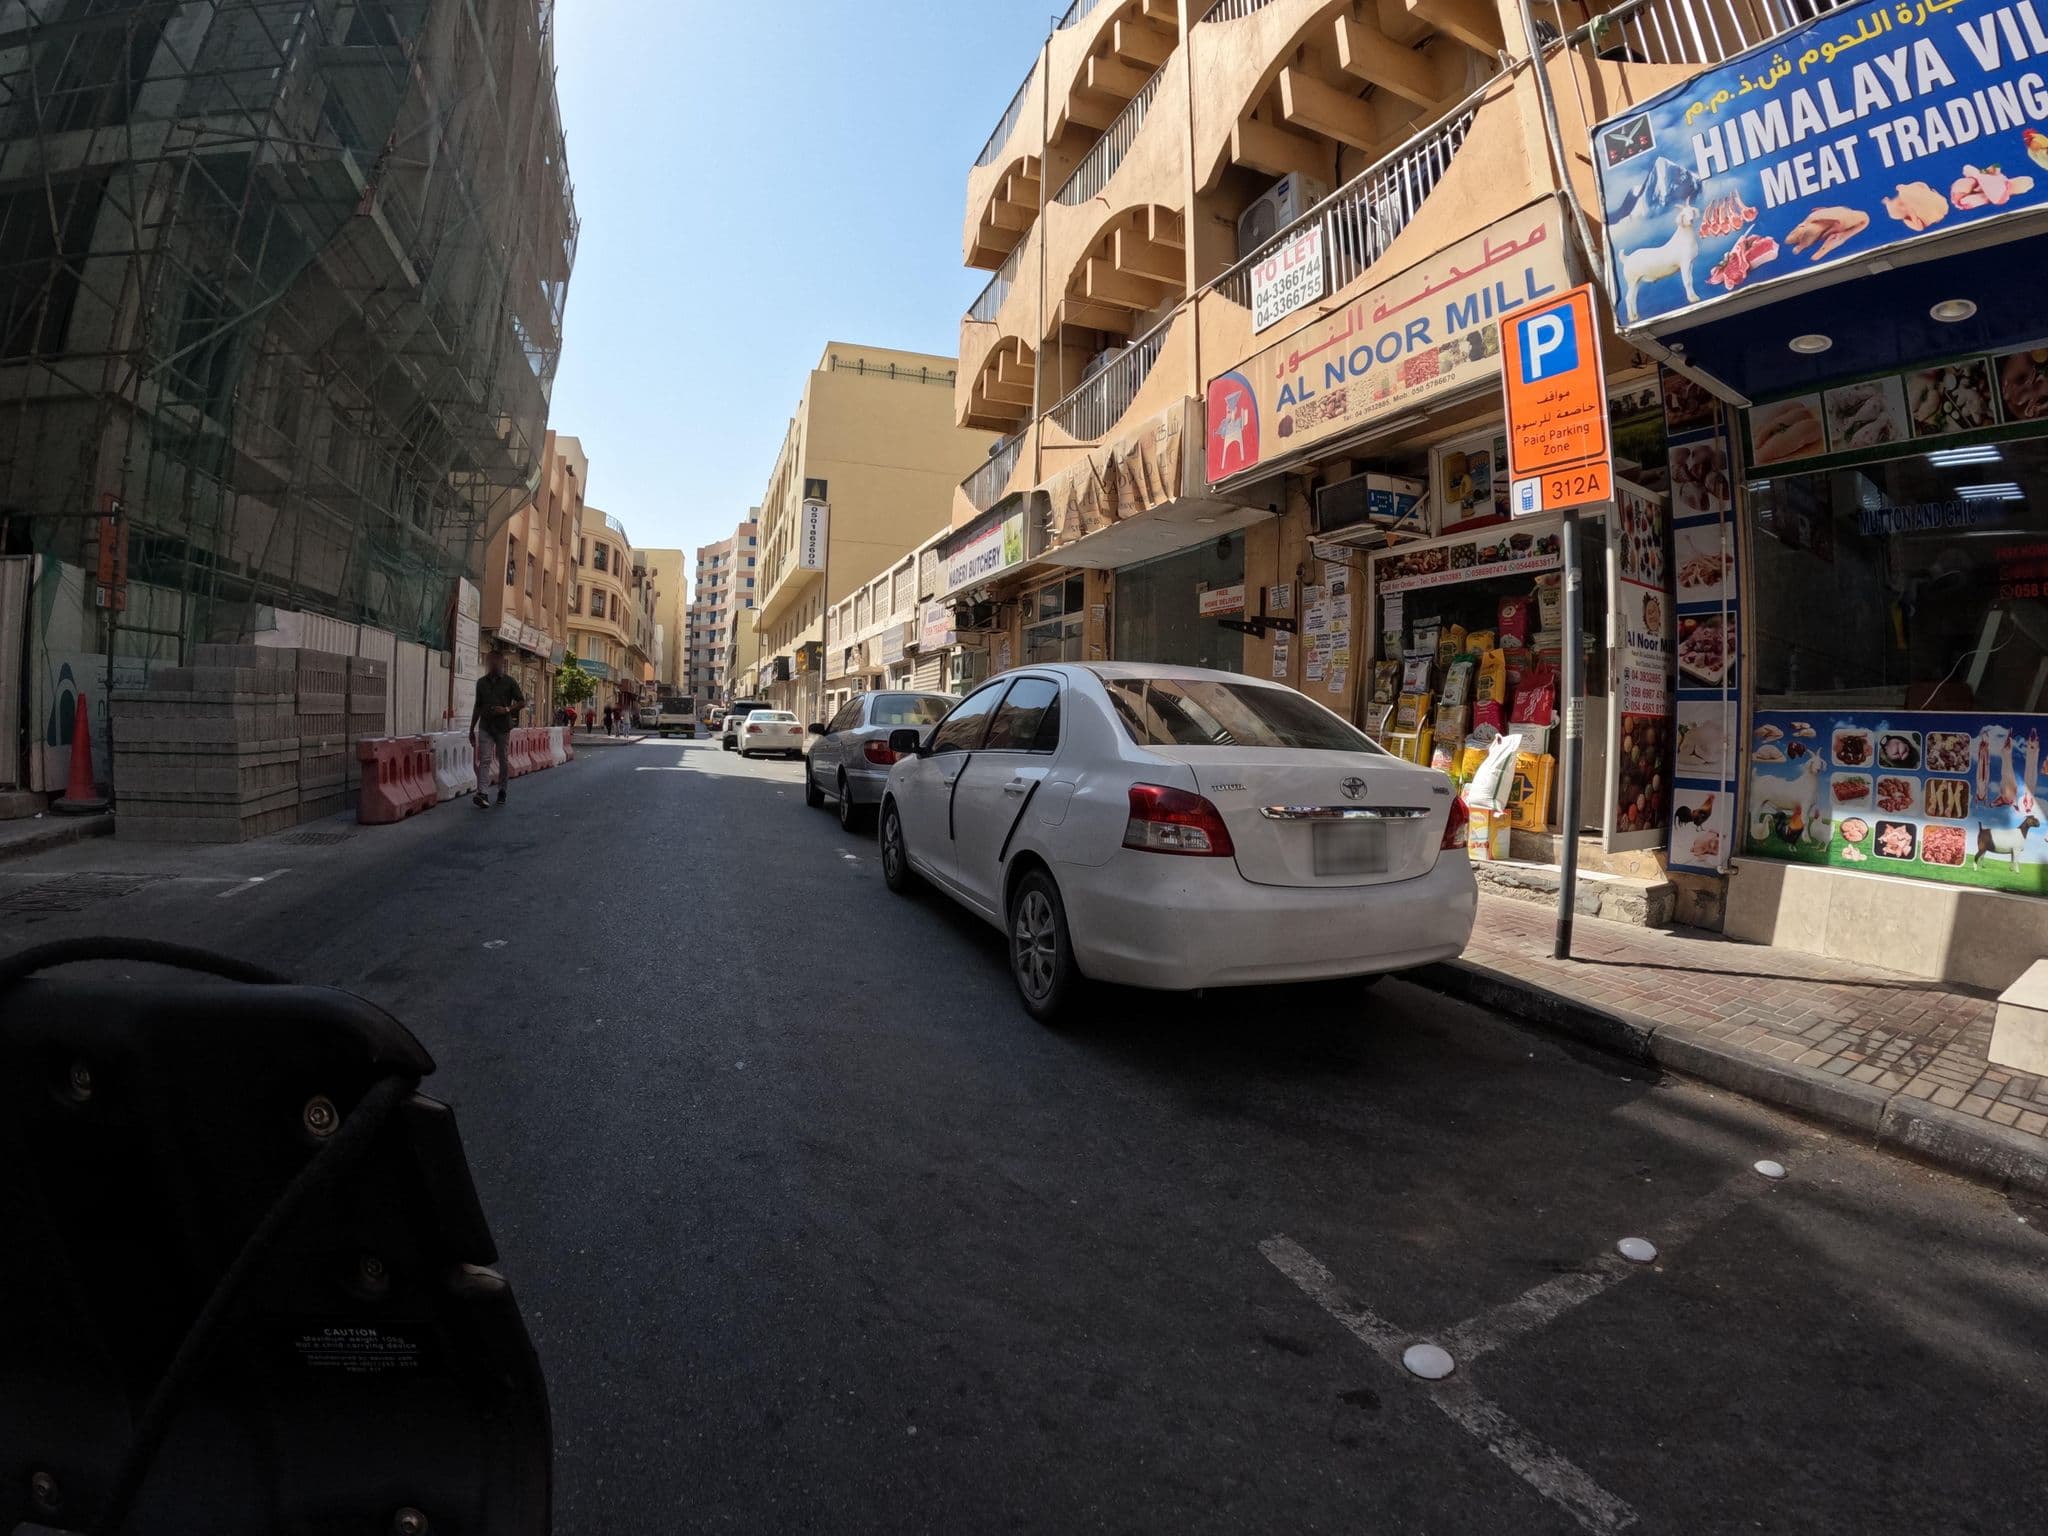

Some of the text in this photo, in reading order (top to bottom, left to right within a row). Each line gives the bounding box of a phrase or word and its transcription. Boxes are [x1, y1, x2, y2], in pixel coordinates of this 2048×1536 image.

[1798, 9, 1893, 73] اللحوم
[1692, 37, 1957, 180] HIMALAYA
[1760, 72, 2048, 209] MEAT TRADING
[1254, 231, 1317, 288] TO LET
[1256, 256, 1320, 309] 04-3366744
[1257, 276, 1321, 327] 04-3366755
[1276, 222, 1547, 379] مطحنة النور
[1276, 267, 1555, 412] AL NOOR MILL
[1527, 313, 1564, 379] P
[1537, 390, 1570, 405] مواقف
[1515, 411, 1551, 432] للرسوم
[1523, 422, 1590, 447] Paid Parking
[1543, 442, 1570, 456] Zone
[1552, 473, 1600, 499] 312A
[1915, 502, 1942, 529] AND
[969, 544, 1001, 578] BUTCHERY
[1637, 633, 1658, 651] Noor
[1211, 783, 1247, 793] TOYOTA
[323, 1328, 377, 1336] CAUTION
